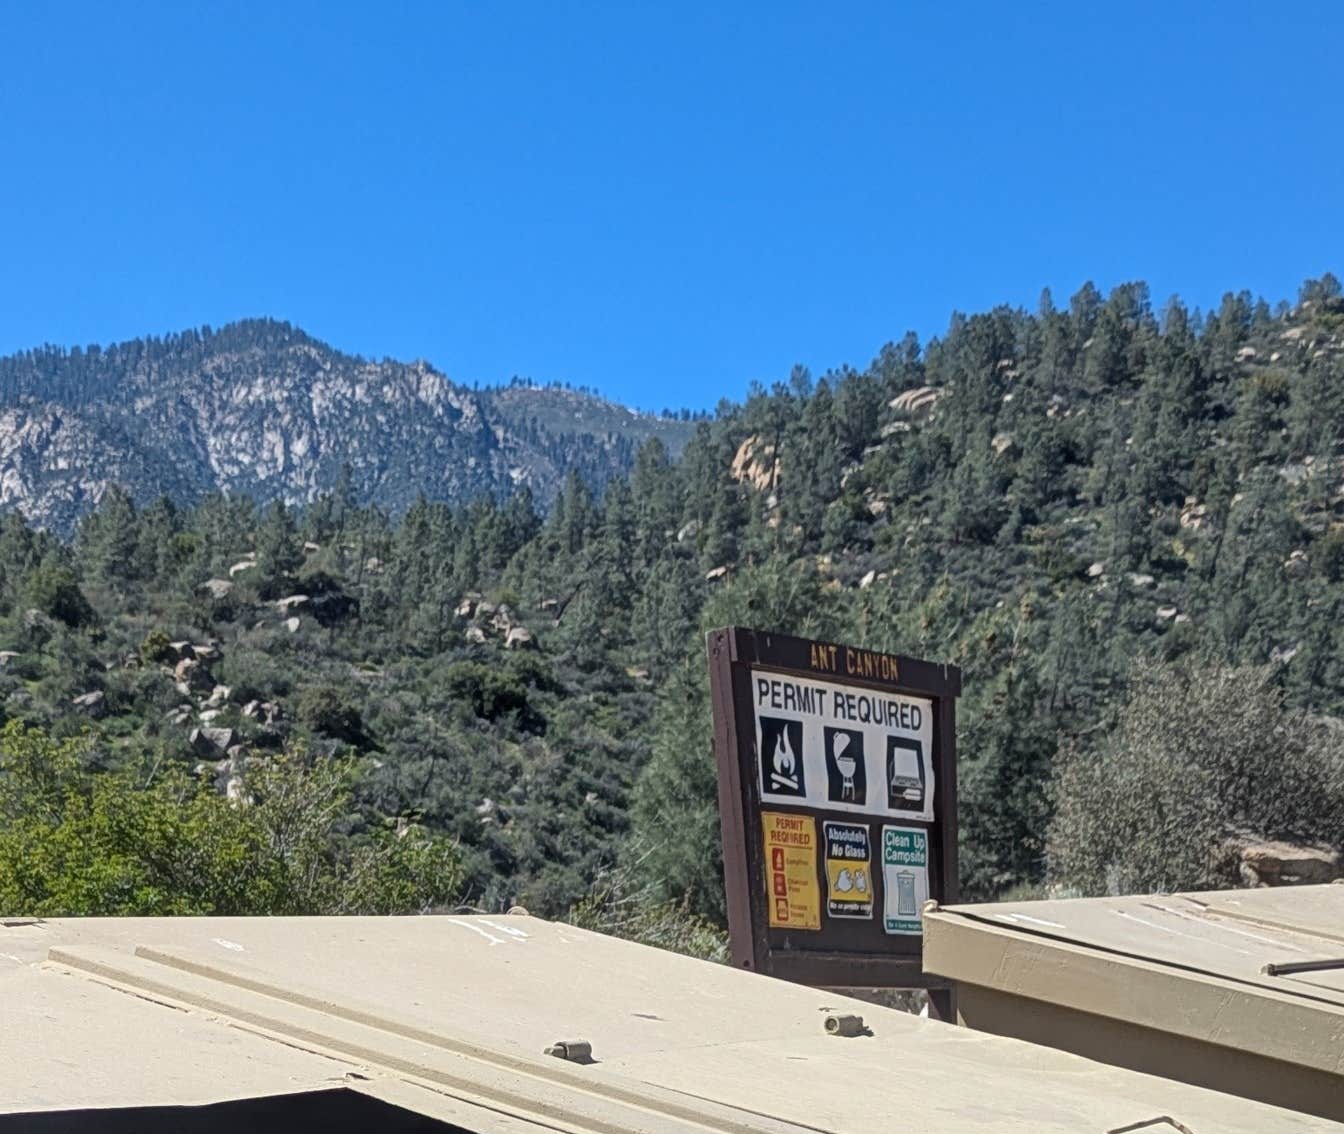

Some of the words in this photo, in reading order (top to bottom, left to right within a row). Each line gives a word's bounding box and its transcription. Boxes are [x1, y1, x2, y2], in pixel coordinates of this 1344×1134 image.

[811, 644, 837, 672] ANT
[846, 647, 898, 681] CANYON
[757, 678, 827, 716] PERMIT
[833, 691, 922, 731] REQUIRED
[776, 818, 804, 831] PERMIT
[770, 830, 810, 845] REQUIRED
[828, 828, 866, 845] Absolutely
[885, 831, 910, 848] Clean
[913, 834, 925, 851] Up
[831, 843, 843, 856] No
[844, 844, 866, 858] Glass
[885, 846, 926, 864] Campsite
